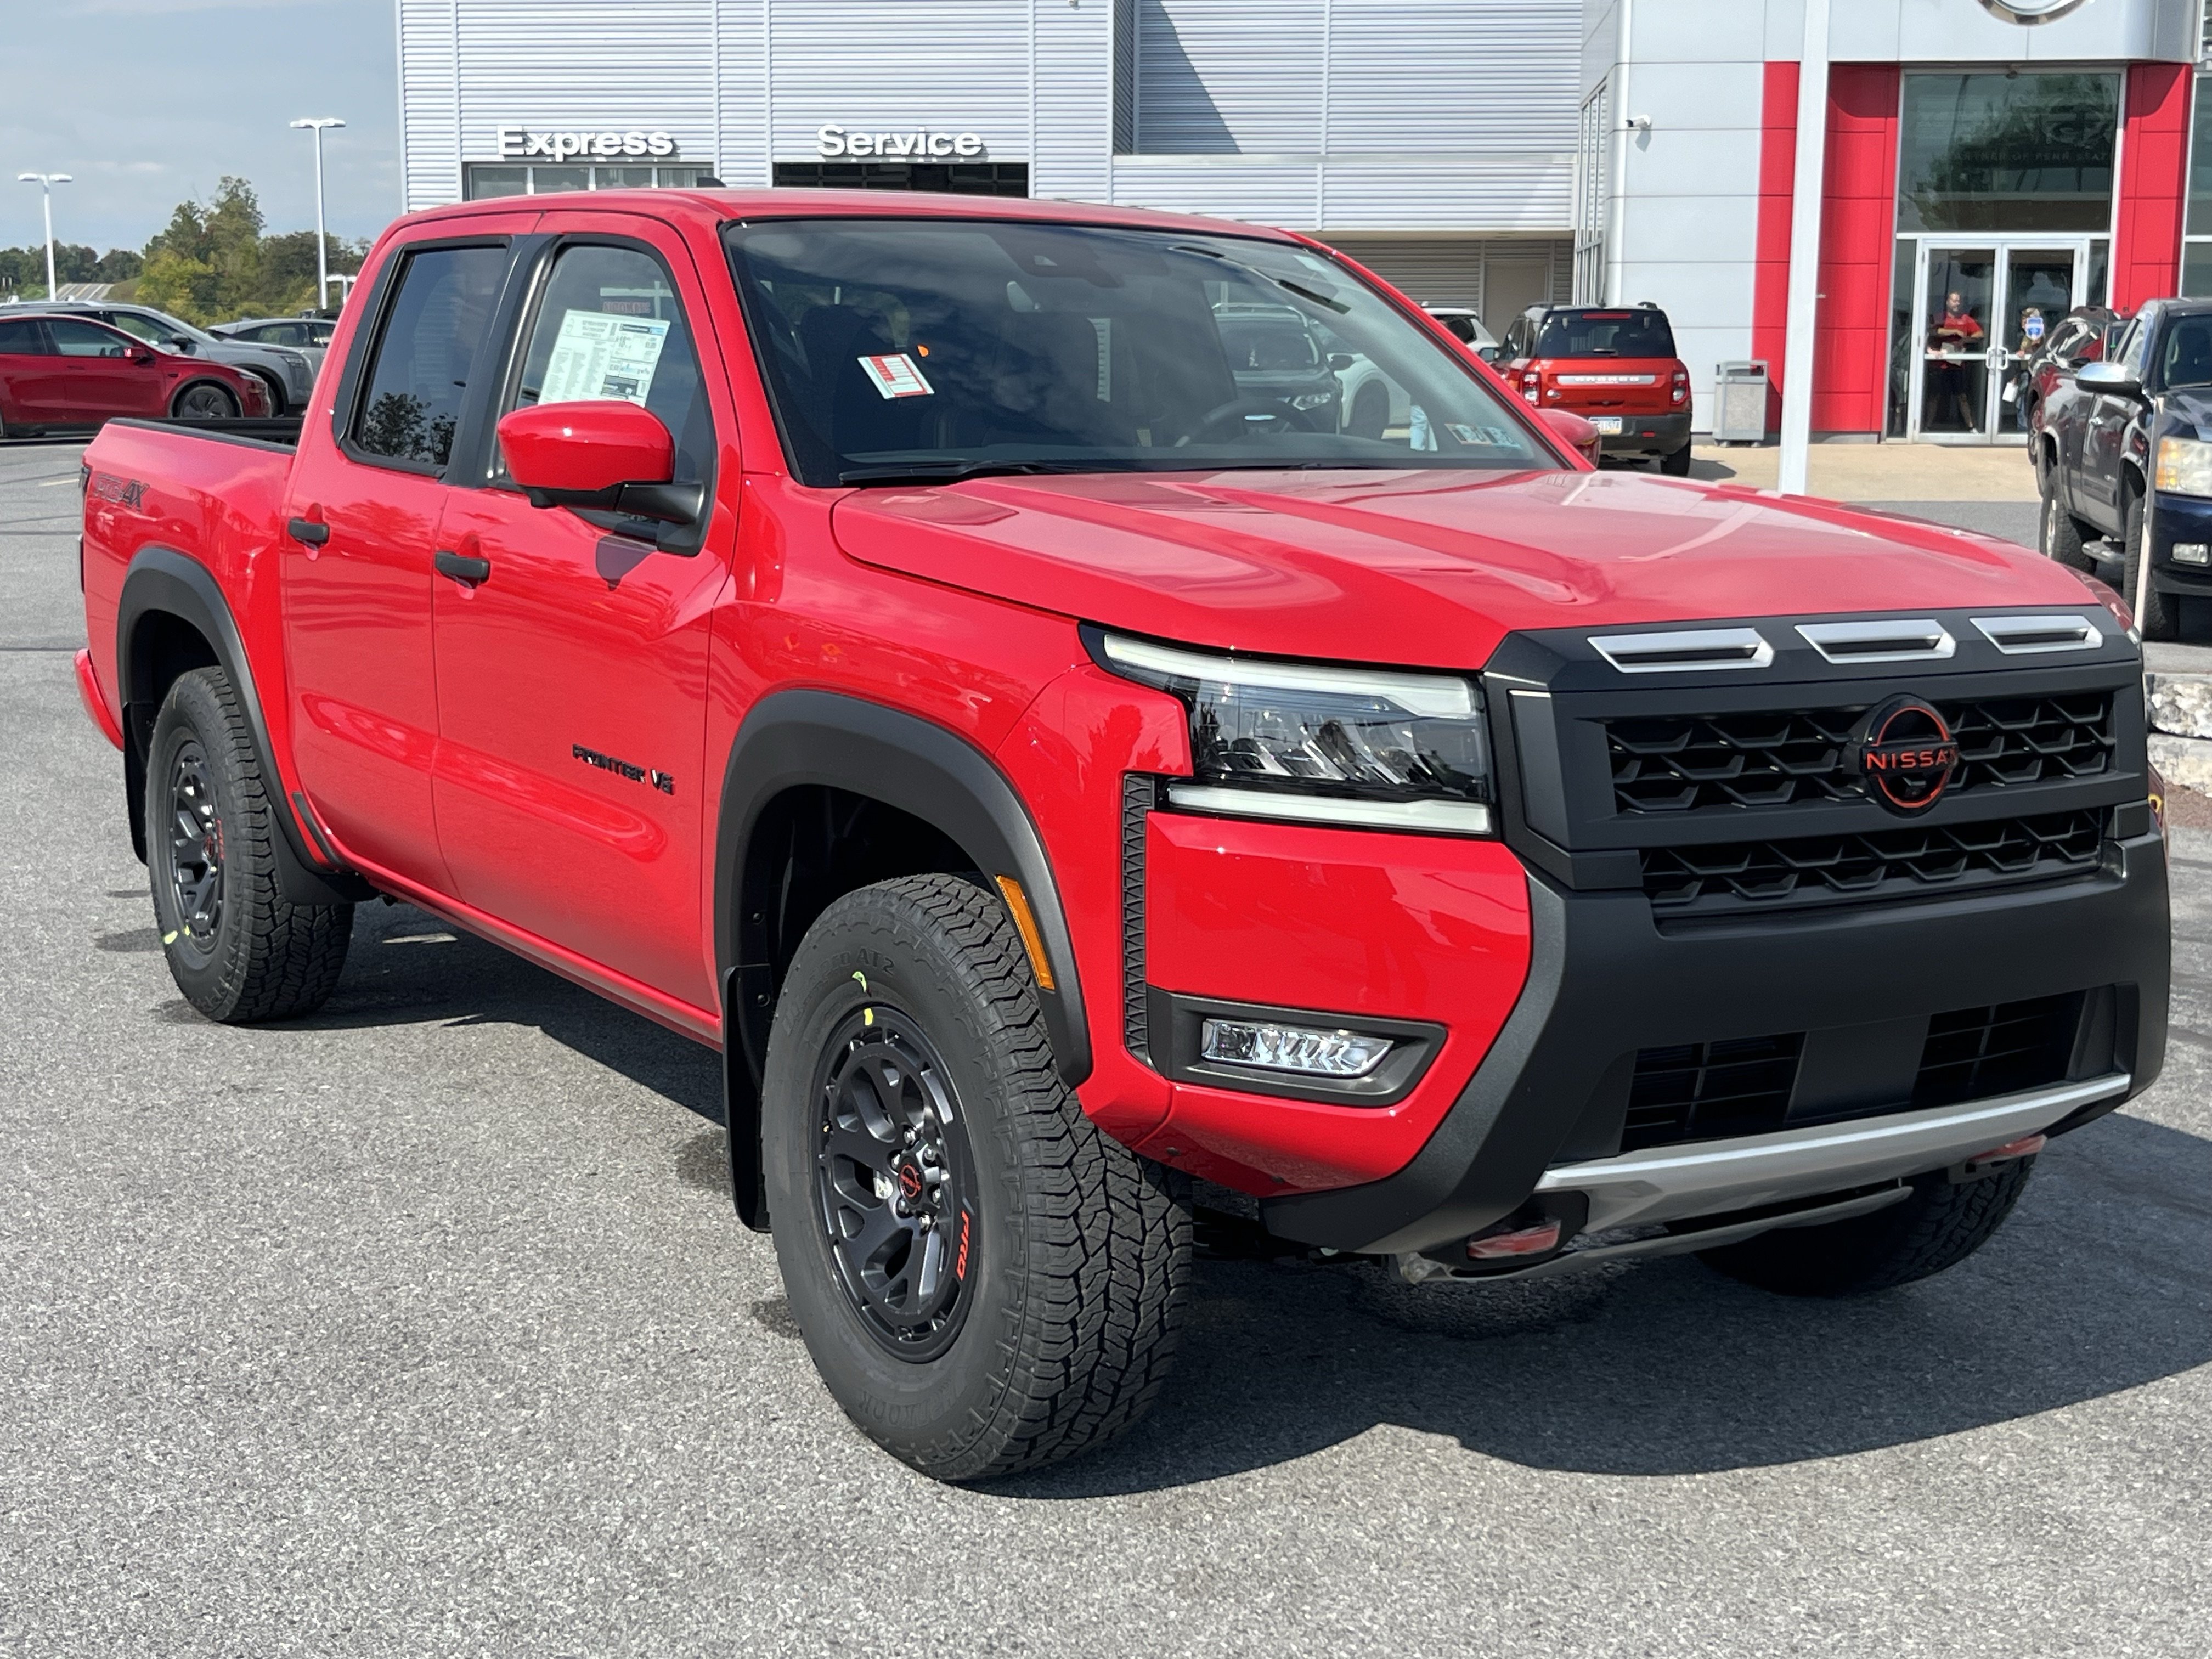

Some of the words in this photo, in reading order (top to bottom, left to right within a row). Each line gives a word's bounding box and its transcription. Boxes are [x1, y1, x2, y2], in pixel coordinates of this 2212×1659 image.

[496, 125, 674, 161] Express
[817, 124, 983, 156] Service
[1866, 748, 1956, 770] NISSAN
[650, 768, 675, 795] V6
[956, 1209, 970, 1282] PRO
